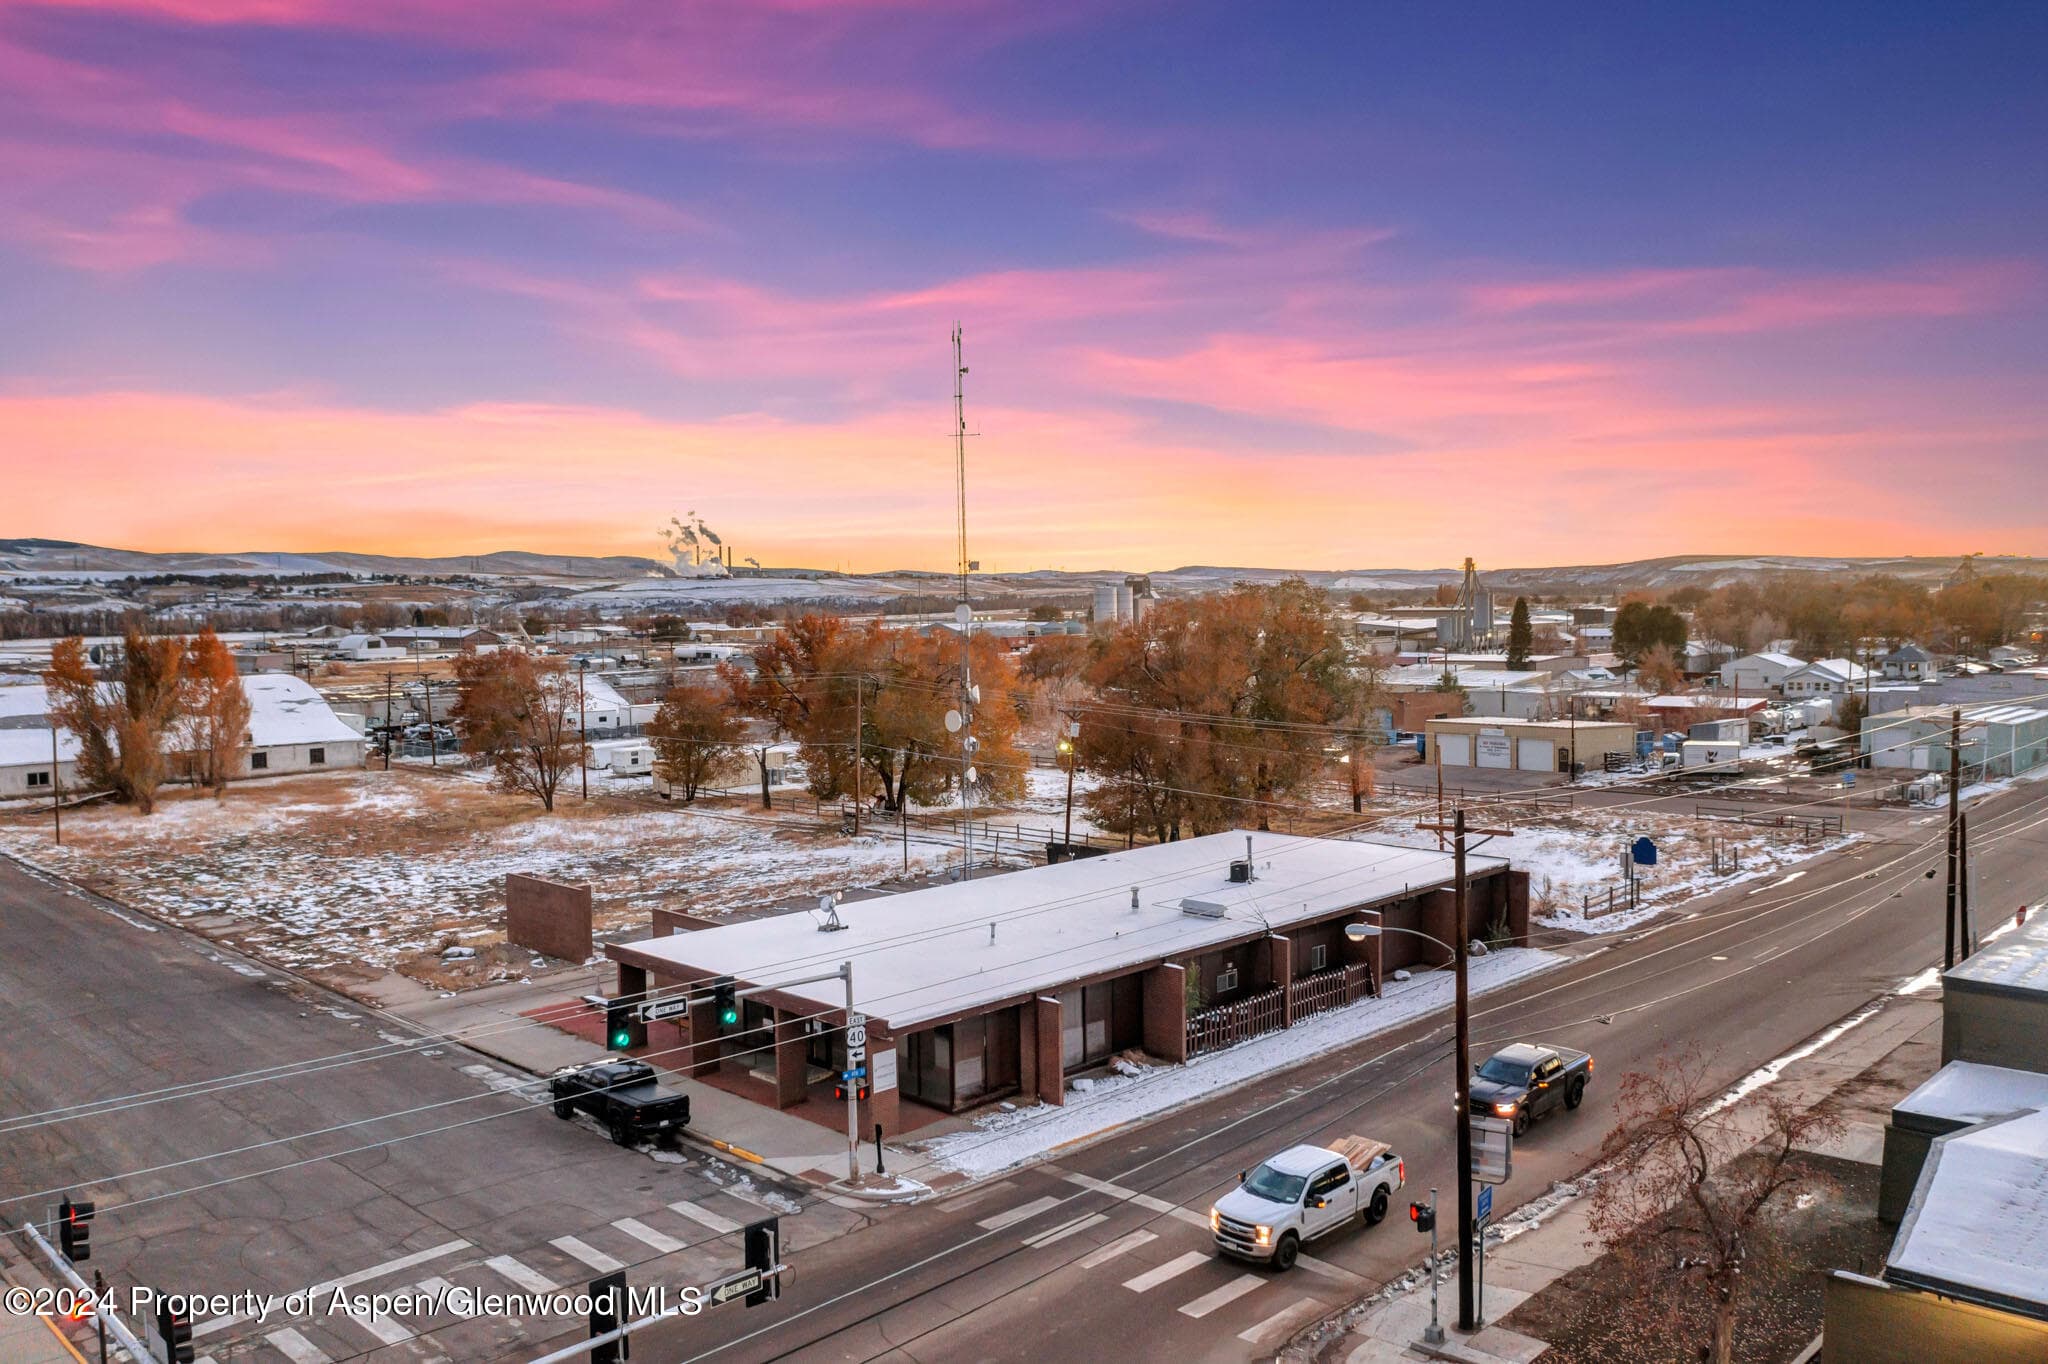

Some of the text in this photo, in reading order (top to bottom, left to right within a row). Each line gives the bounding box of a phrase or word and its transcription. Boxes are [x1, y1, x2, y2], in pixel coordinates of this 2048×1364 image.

[656, 1007, 666, 1015] ONE
[849, 1016, 864, 1025] EAST
[850, 1030, 864, 1043] 40
[724, 1278, 757, 1297] ONE WAY
